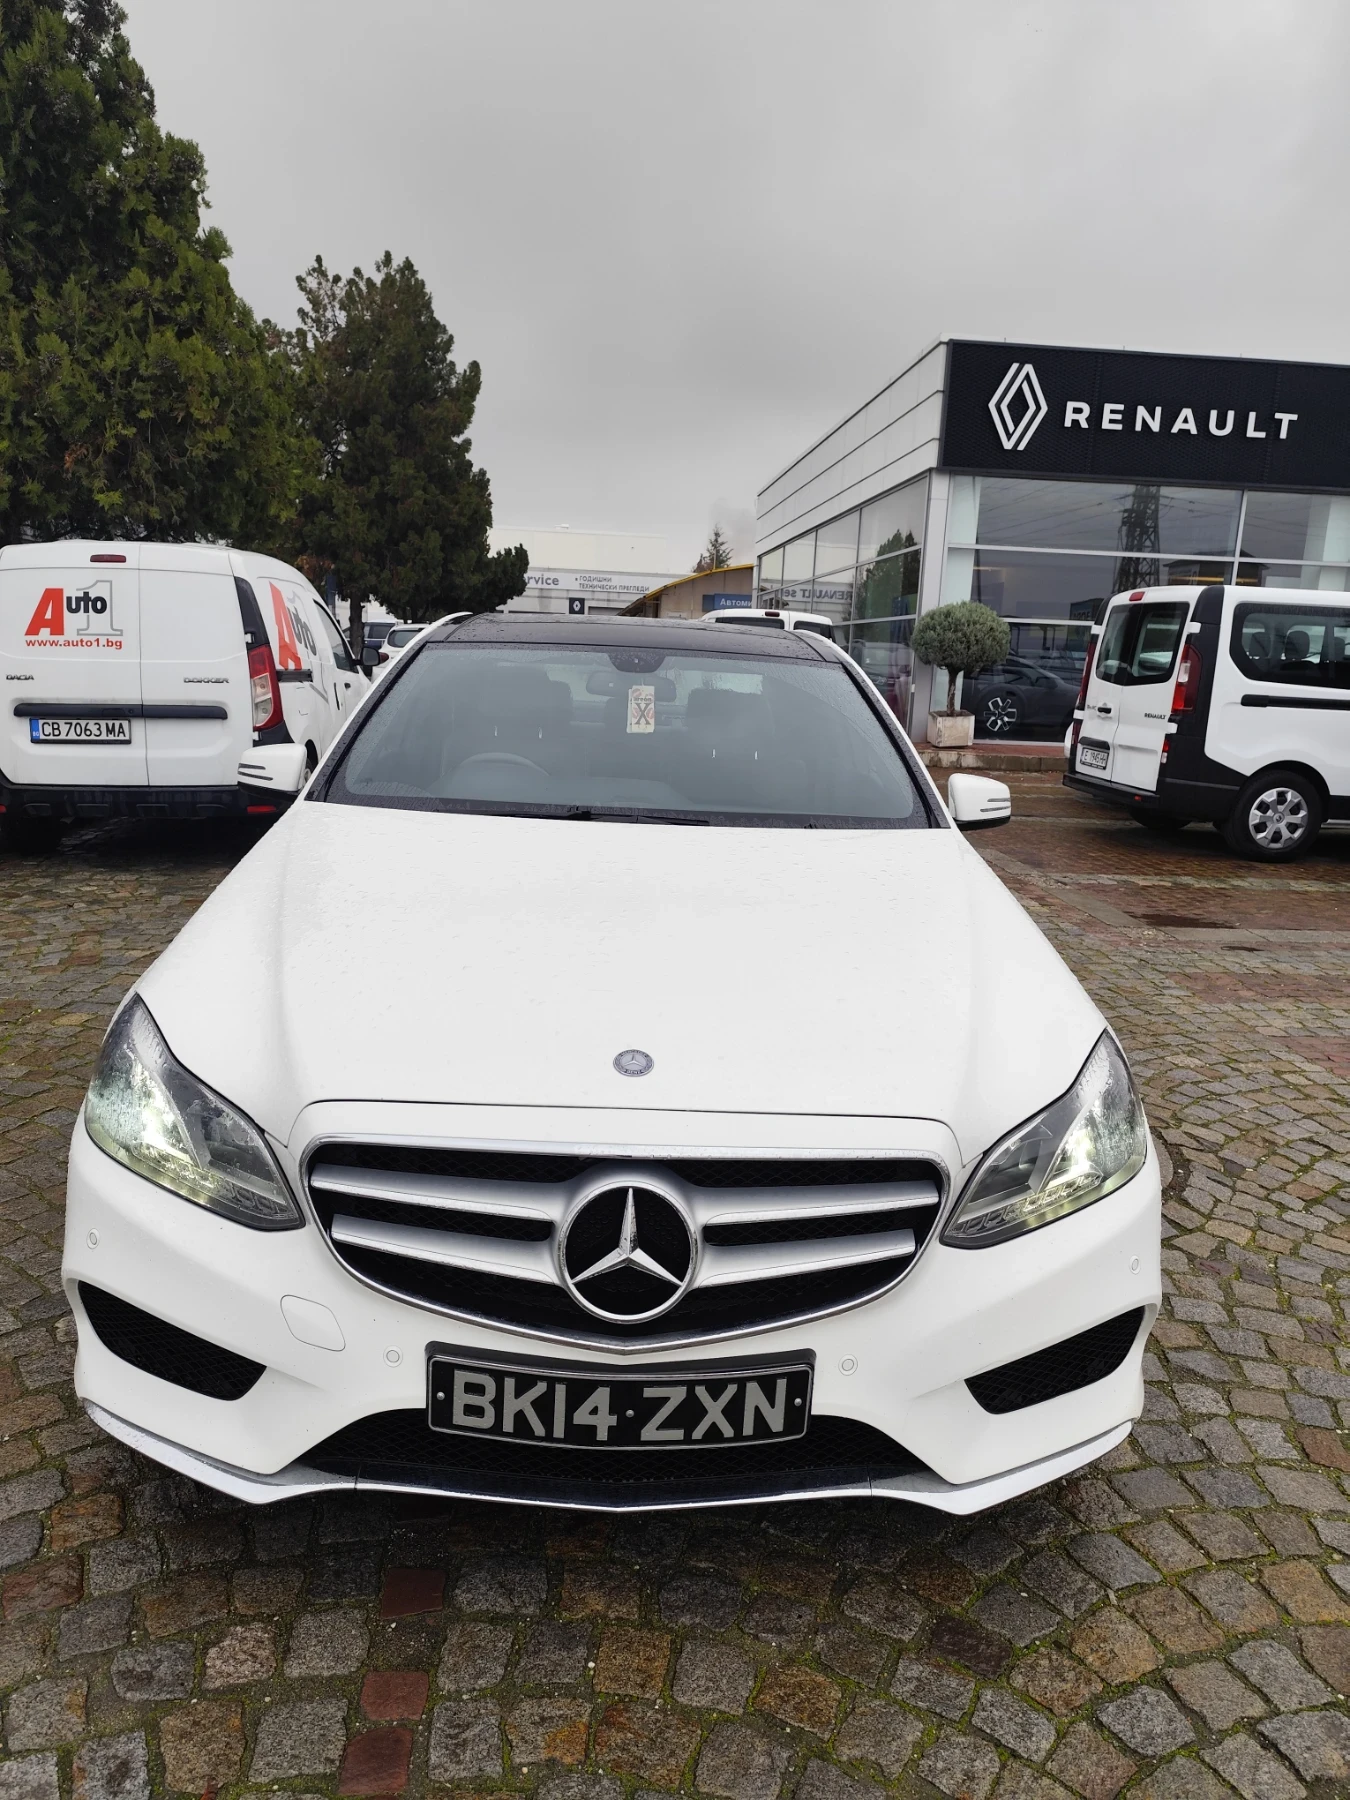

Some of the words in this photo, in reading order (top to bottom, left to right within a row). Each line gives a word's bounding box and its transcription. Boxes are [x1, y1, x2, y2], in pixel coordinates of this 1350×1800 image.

[1064, 401, 1299, 440] RENAULT
[526, 573, 560, 586] rvice
[25, 637, 124, 650] www.auto1.bg
[6, 674, 35, 682] DACIA
[183, 676, 230, 684] DOKKER
[1144, 712, 1166, 720] RENAULT
[64, 721, 102, 738] 7063
[105, 722, 127, 738] MA
[640, 1377, 788, 1442] ZXN
